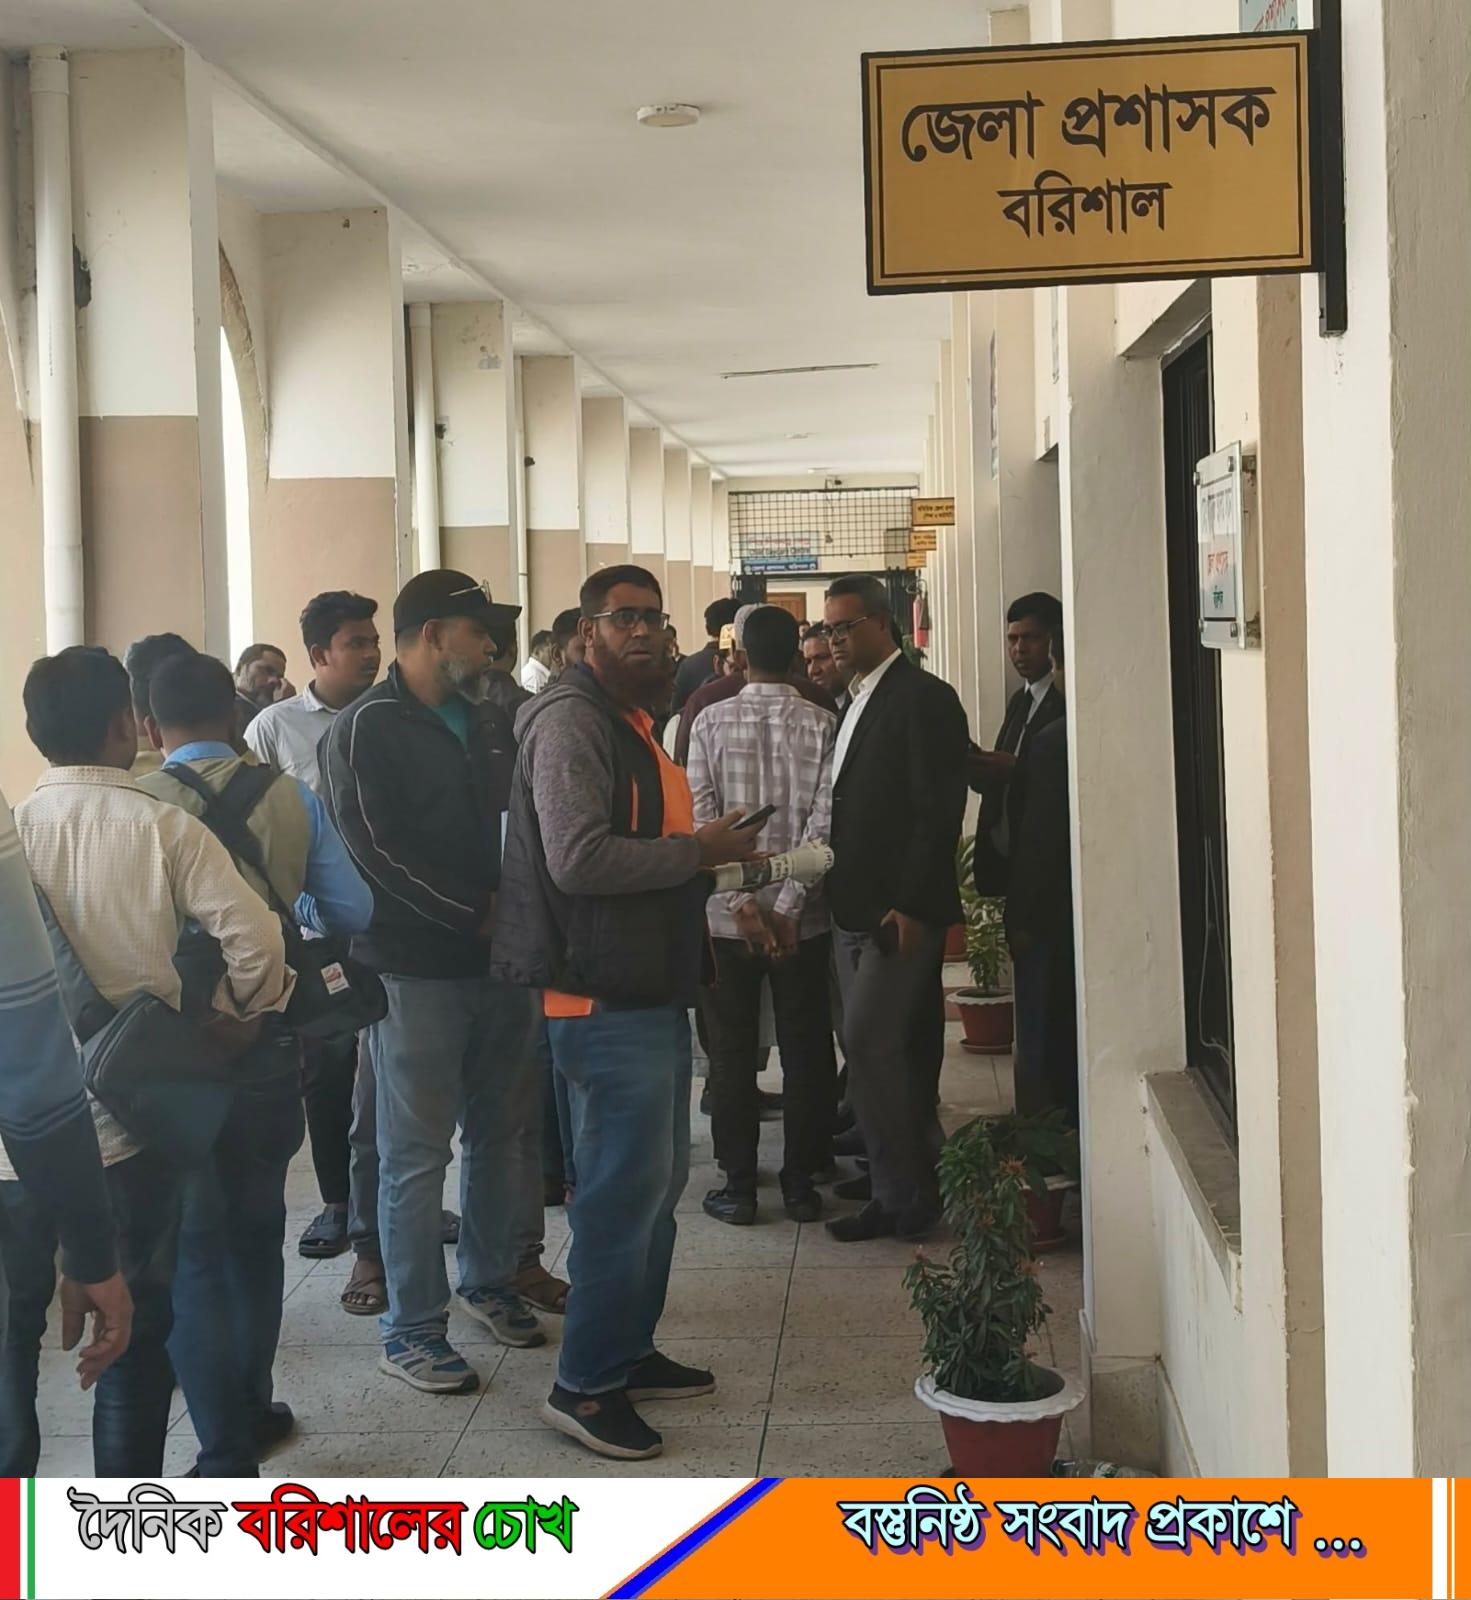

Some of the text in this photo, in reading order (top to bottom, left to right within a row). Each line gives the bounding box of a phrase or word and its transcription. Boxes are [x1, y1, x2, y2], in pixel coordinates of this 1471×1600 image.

[902, 84, 1276, 162] জেলা প্রশাসক
[997, 170, 1172, 238] বরিশাল
